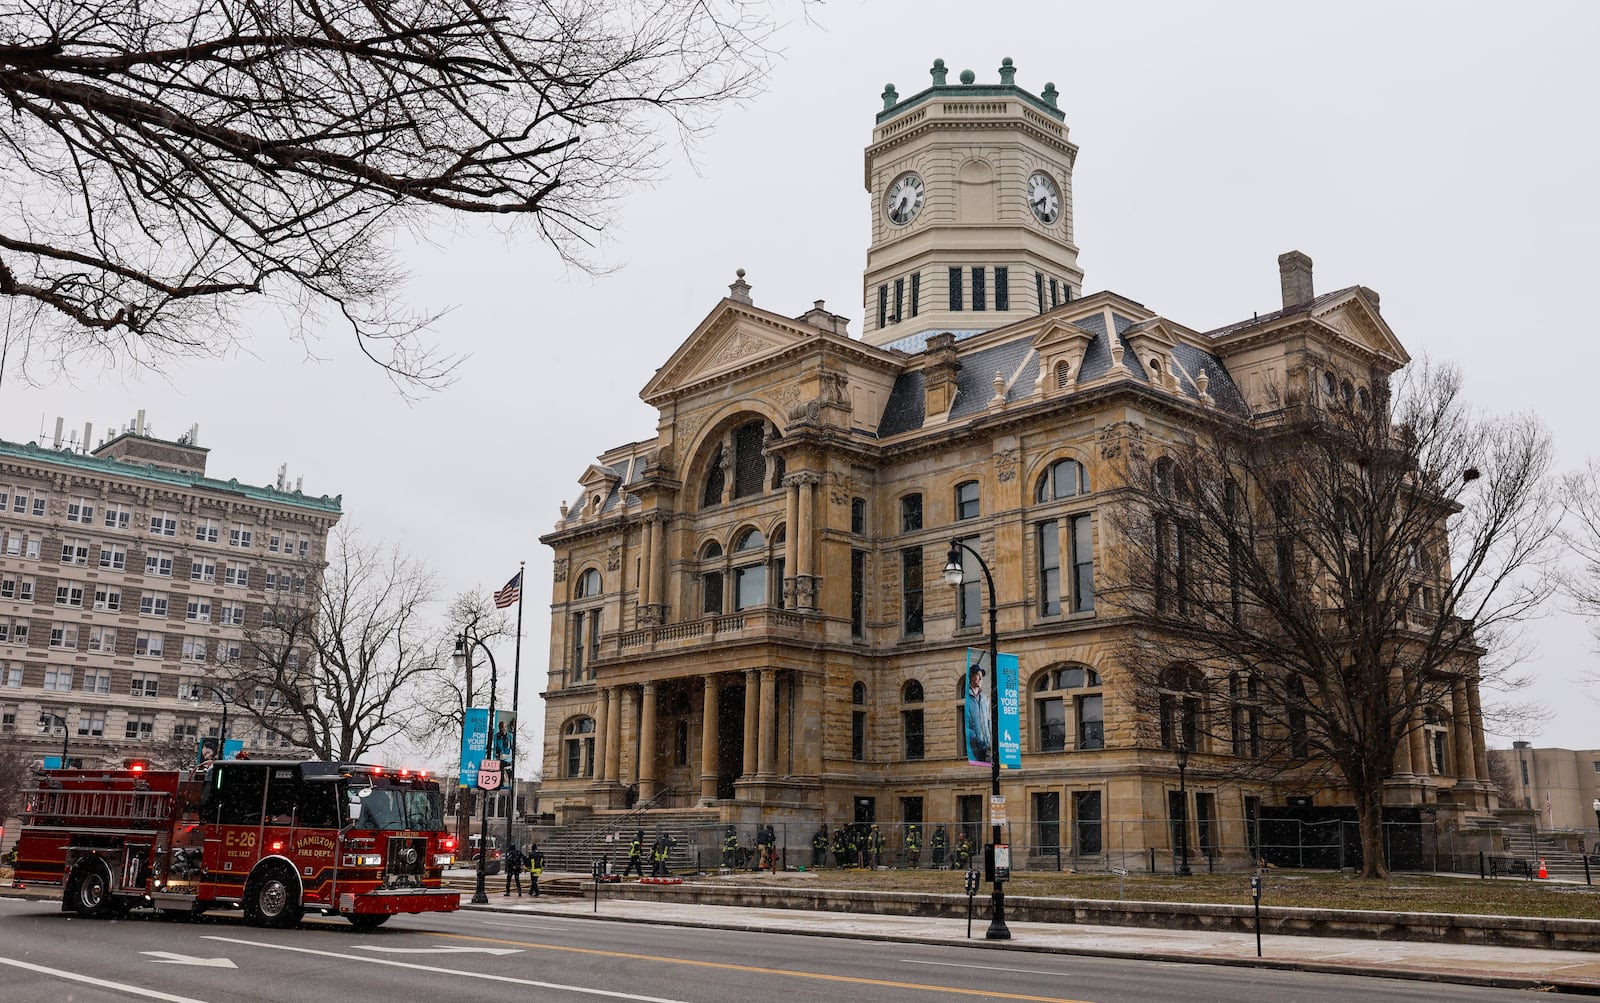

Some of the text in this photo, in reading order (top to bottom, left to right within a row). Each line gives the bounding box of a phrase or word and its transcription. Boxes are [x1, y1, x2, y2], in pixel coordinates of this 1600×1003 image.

[1005, 689, 1018, 698] FOR
[1000, 697, 1018, 706] YOUR
[1003, 706, 1018, 715] BEST
[481, 775, 498, 785] 129
[225, 830, 256, 847] E-26
[296, 836, 336, 850] HAMILTON
[298, 849, 313, 857] FIRE
